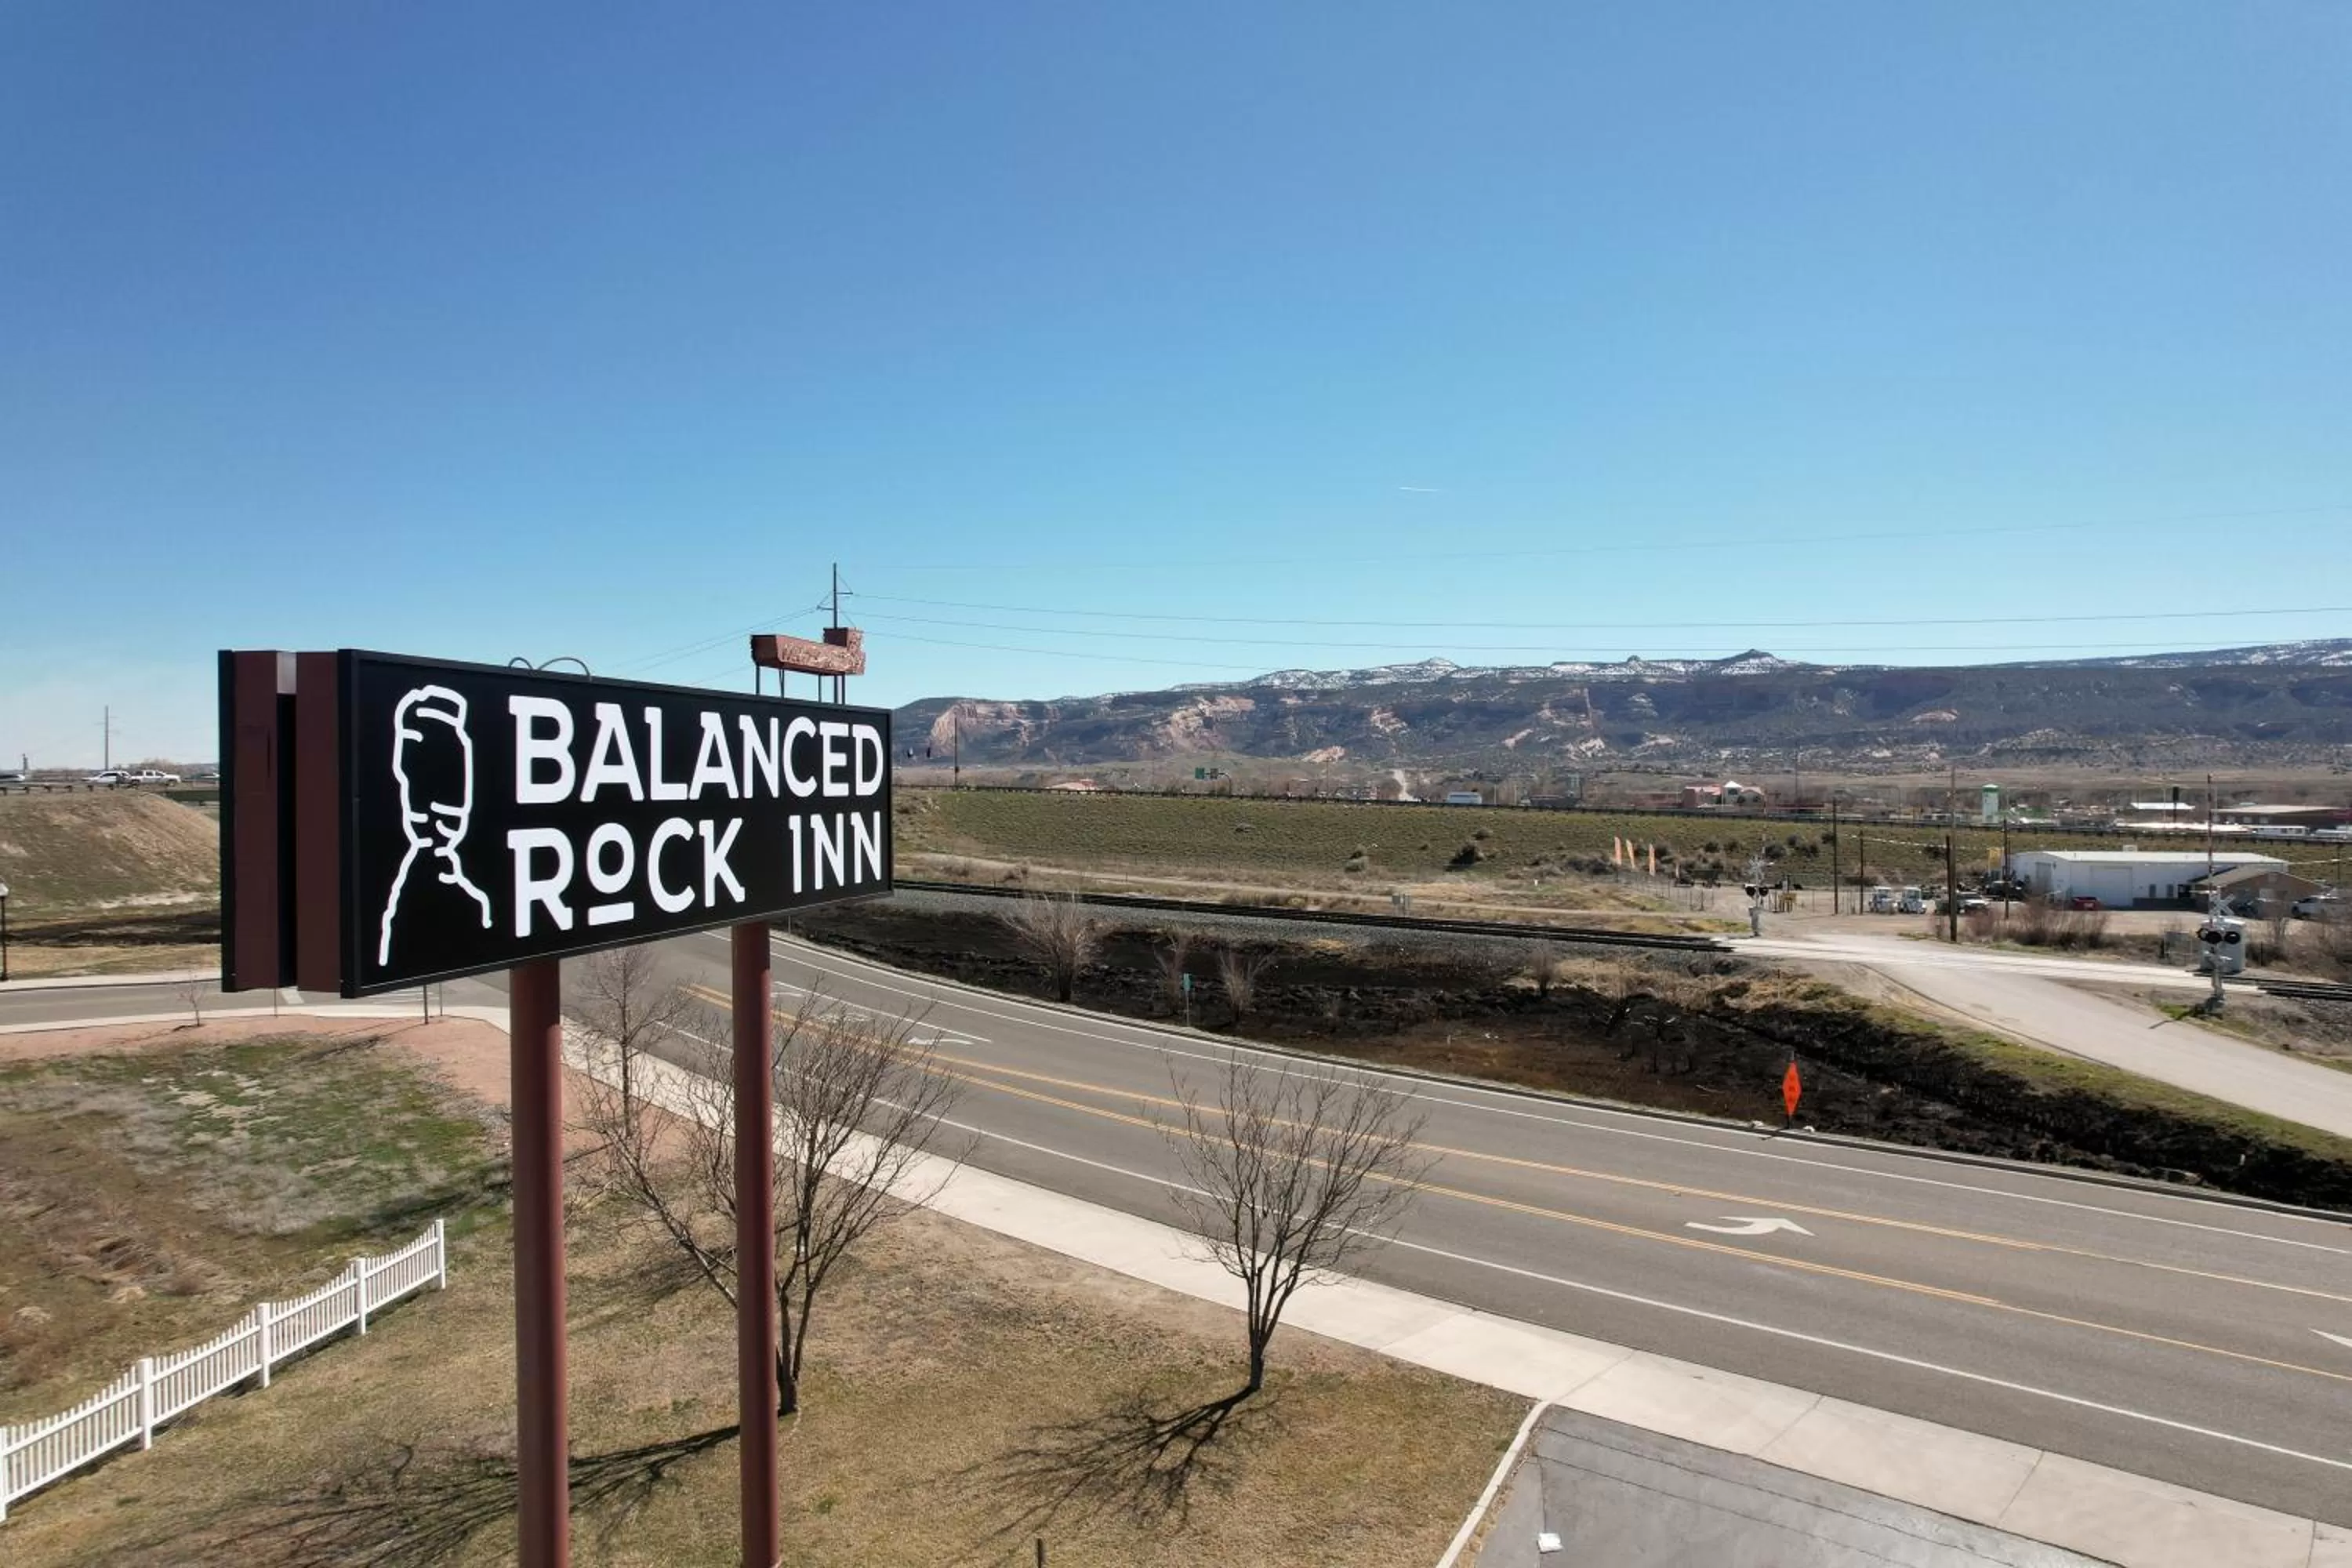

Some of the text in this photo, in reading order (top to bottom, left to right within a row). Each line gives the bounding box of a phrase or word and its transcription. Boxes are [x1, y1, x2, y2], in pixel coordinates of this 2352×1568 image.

[508, 695, 884, 804] BALANCED
[506, 811, 881, 938] ROCK INN
